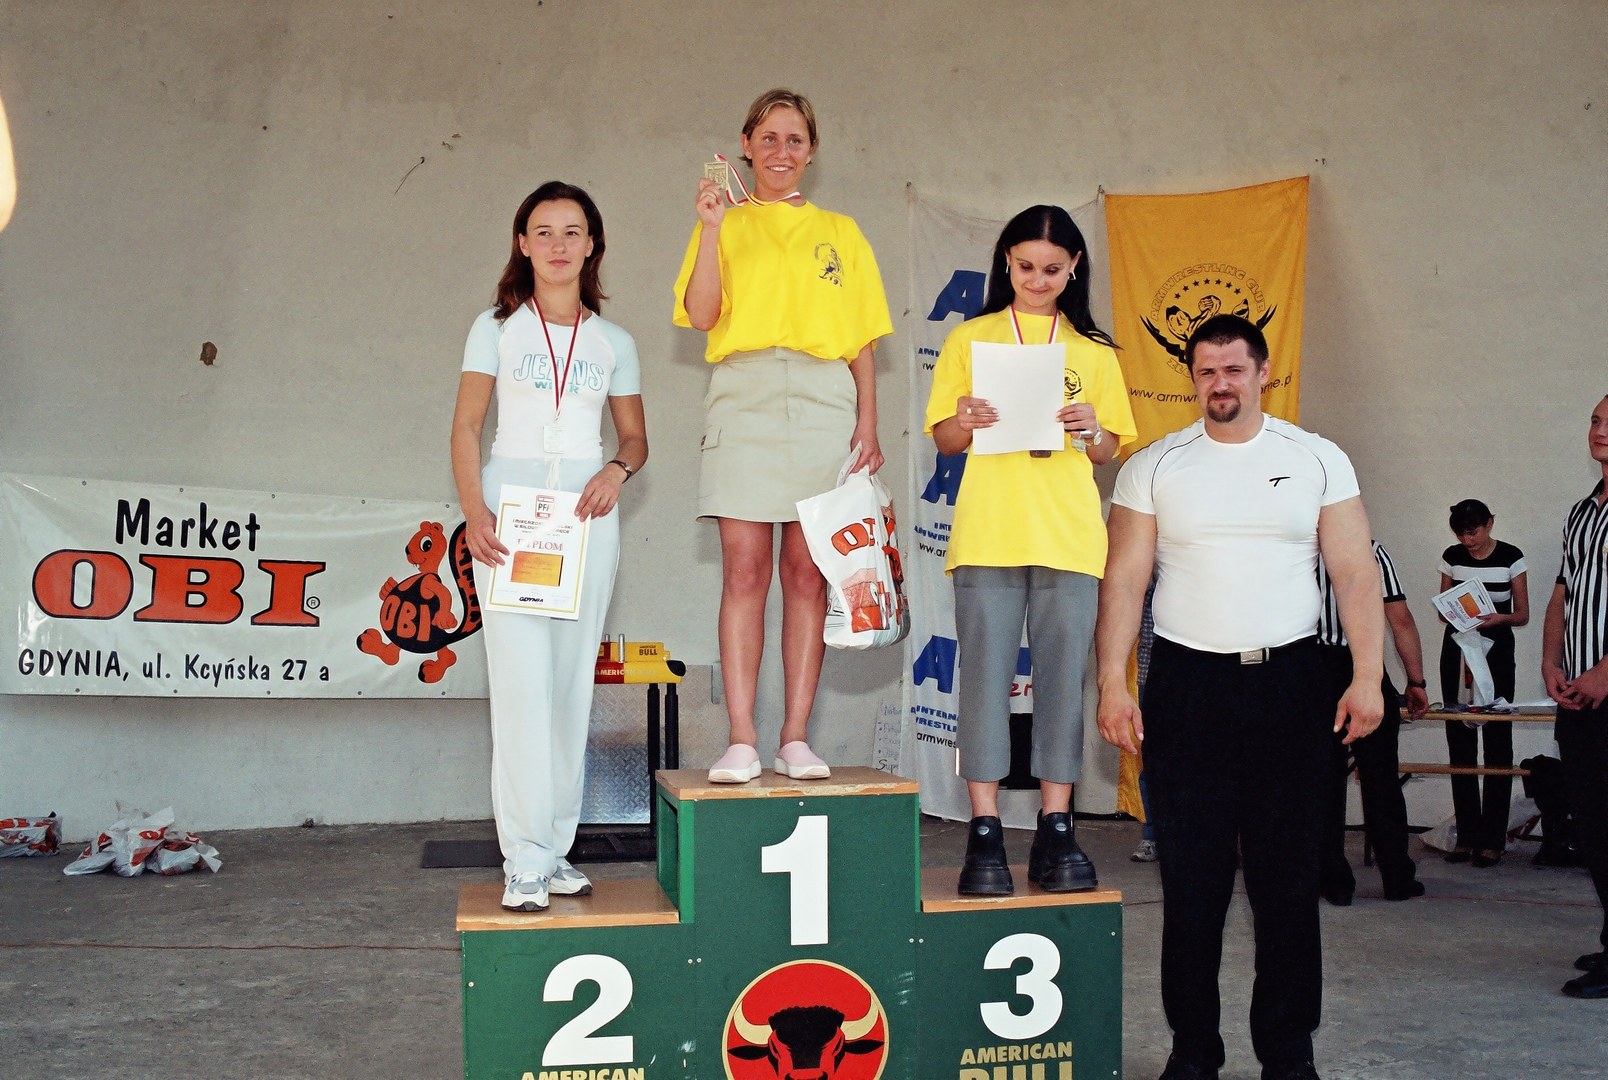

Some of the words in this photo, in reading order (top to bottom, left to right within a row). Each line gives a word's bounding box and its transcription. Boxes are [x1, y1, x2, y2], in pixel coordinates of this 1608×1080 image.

[1150, 263, 1247, 322] ARMWRESTLING
[1245, 278, 1267, 313] CLUB
[513, 353, 605, 391] JEANS
[534, 381, 579, 394] WR
[116, 497, 261, 552] Market
[517, 538, 564, 552] PLOM
[32, 548, 327, 628] OBI
[380, 594, 431, 642] OBI
[18, 648, 130, 682] GDYNIA,
[142, 652, 171, 679] ul.
[185, 653, 271, 688] Kcyńska
[281, 658, 308, 681] 27
[319, 665, 330, 682] a
[638, 648, 658, 656] BULL
[761, 814, 828, 946] 1
[979, 933, 1064, 1040] 3
[541, 953, 635, 1066] 2
[520, 1067, 645, 1080] AMERICAN
[960, 1041, 1073, 1066] AMERICAN
